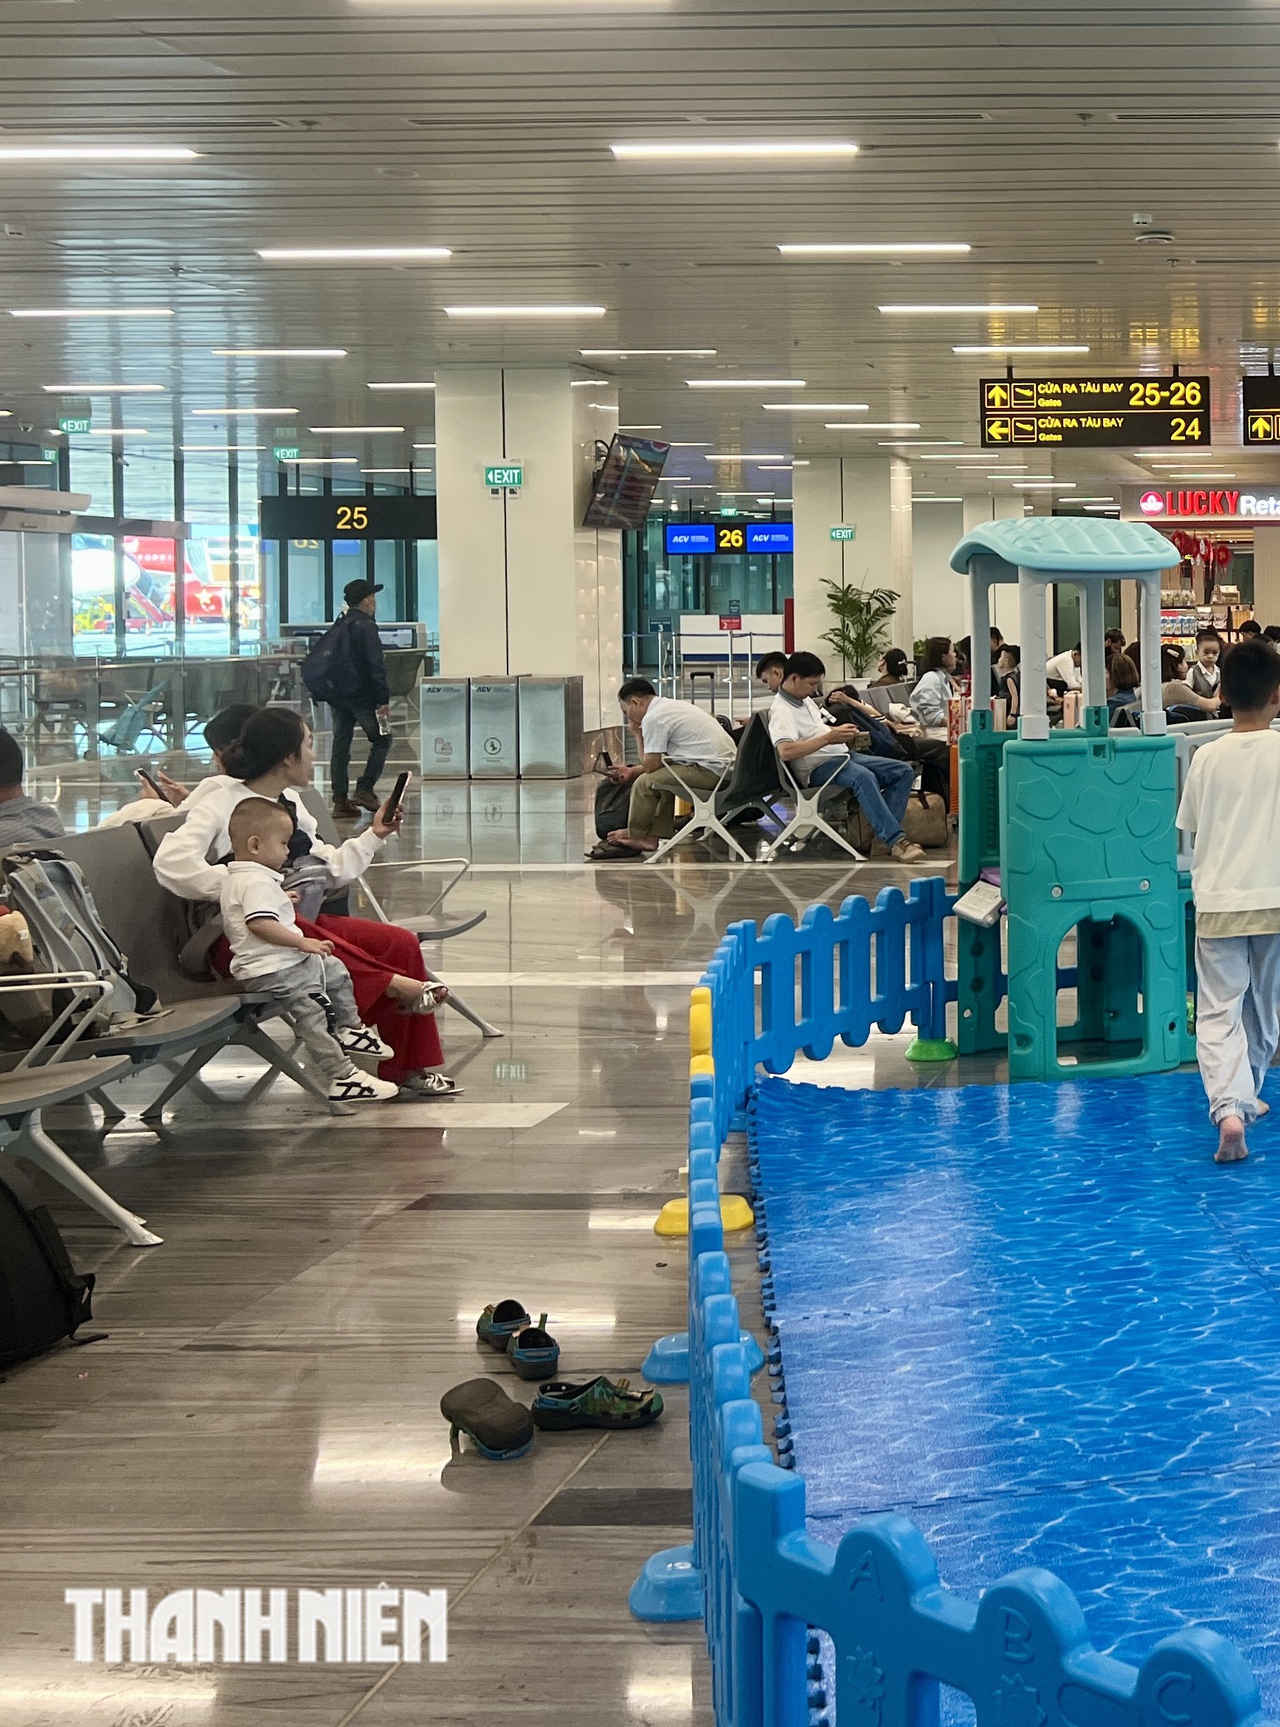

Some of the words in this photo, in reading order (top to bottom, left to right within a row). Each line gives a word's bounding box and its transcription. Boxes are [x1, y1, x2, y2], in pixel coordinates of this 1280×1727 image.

[1037, 381, 1061, 394] CỬA
[1062, 384, 1078, 394] RA
[1079, 382, 1100, 394] TÀU
[1102, 383, 1123, 393] BAY
[1129, 381, 1202, 406] 25-26
[1037, 398, 1062, 407] Gates
[67, 419, 89, 432] EXIT
[1038, 416, 1062, 428] CỬA
[1063, 418, 1078, 428] RA
[1079, 416, 1101, 428] TÀU
[1102, 418, 1124, 428] BAY
[1170, 417, 1202, 441] 24
[1038, 433, 1063, 442] Gates
[281, 448, 299, 459] EXIT
[494, 469, 520, 484] EXIT
[1165, 490, 1240, 516] LUCKY
[336, 506, 369, 530] 25
[672, 535, 690, 543] ACV
[719, 529, 743, 548] 26
[752, 534, 770, 542] ACV
[836, 529, 853, 539] EXIT
[657, 624, 664, 632] 3
[426, 686, 442, 694] ACV
